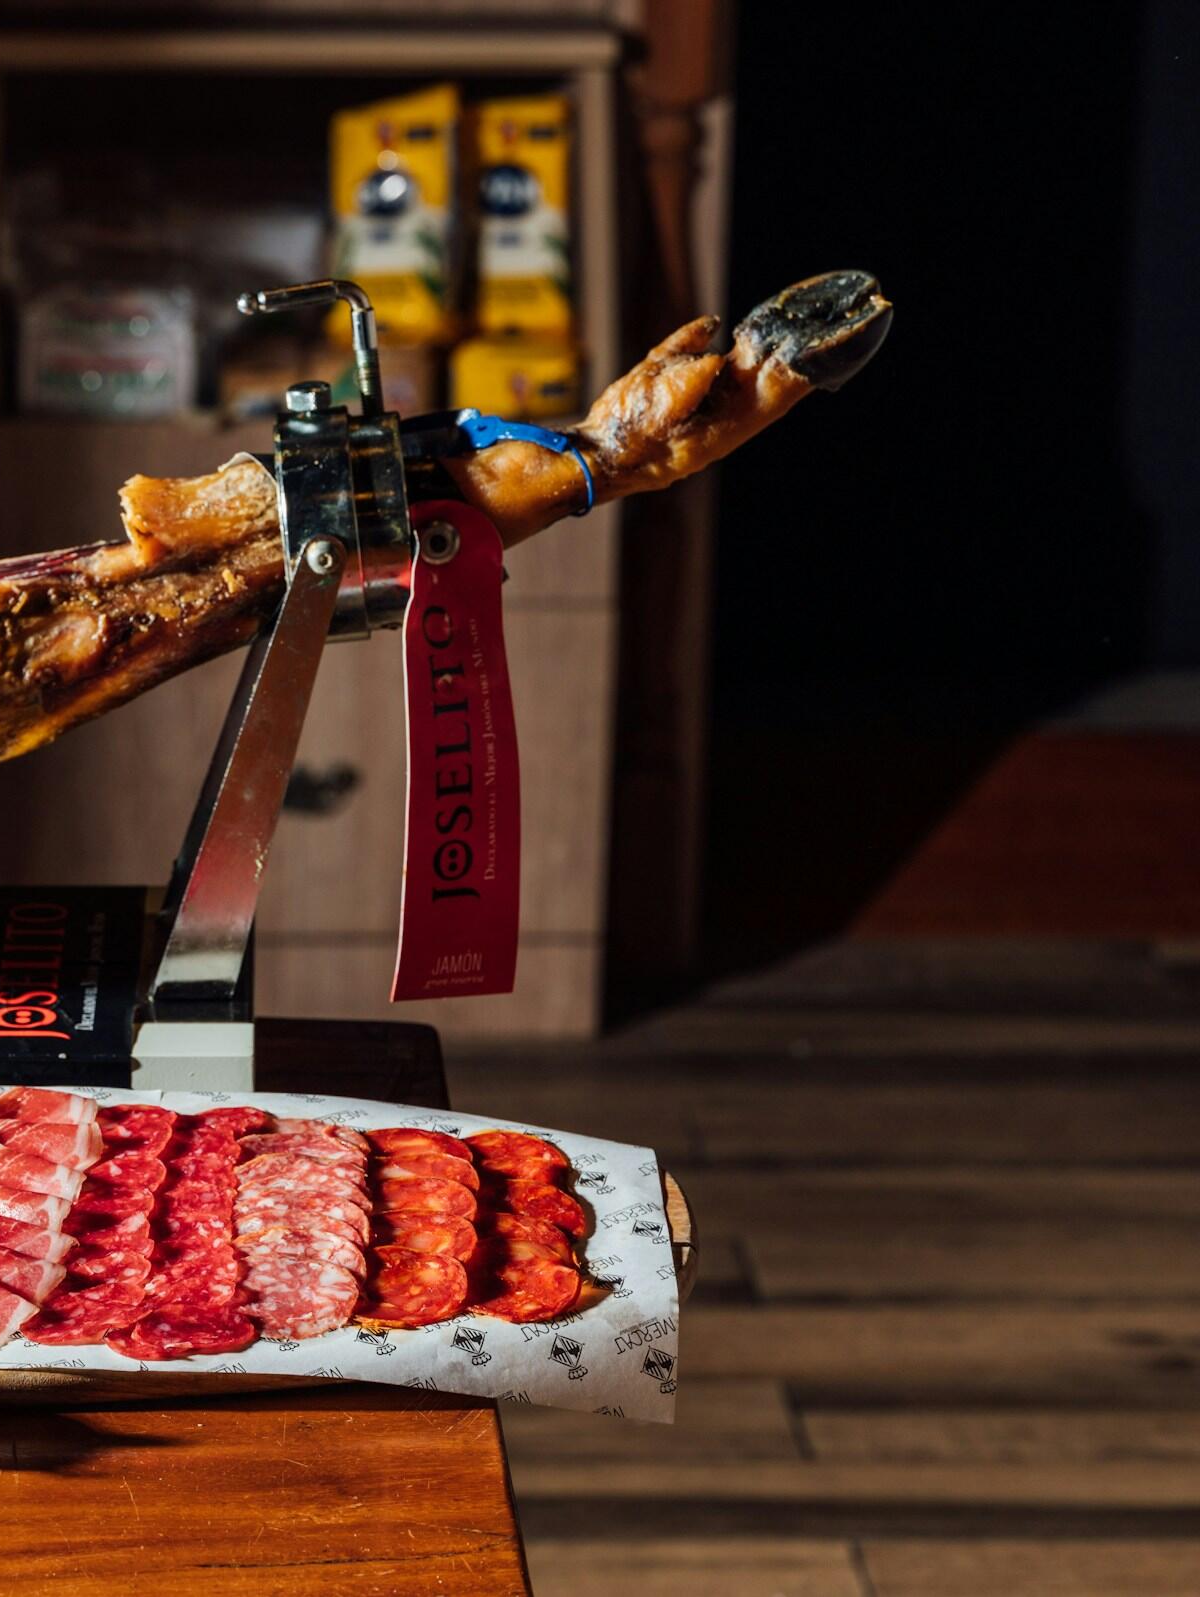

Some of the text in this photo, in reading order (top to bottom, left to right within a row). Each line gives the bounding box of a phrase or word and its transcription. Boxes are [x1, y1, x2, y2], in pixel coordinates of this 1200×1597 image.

[422, 605, 481, 902] JOSELITO
[431, 947, 483, 976] JAMÓN
[600, 1202, 661, 1229] MERCAT
[614, 1316, 677, 1355] MERCAT
